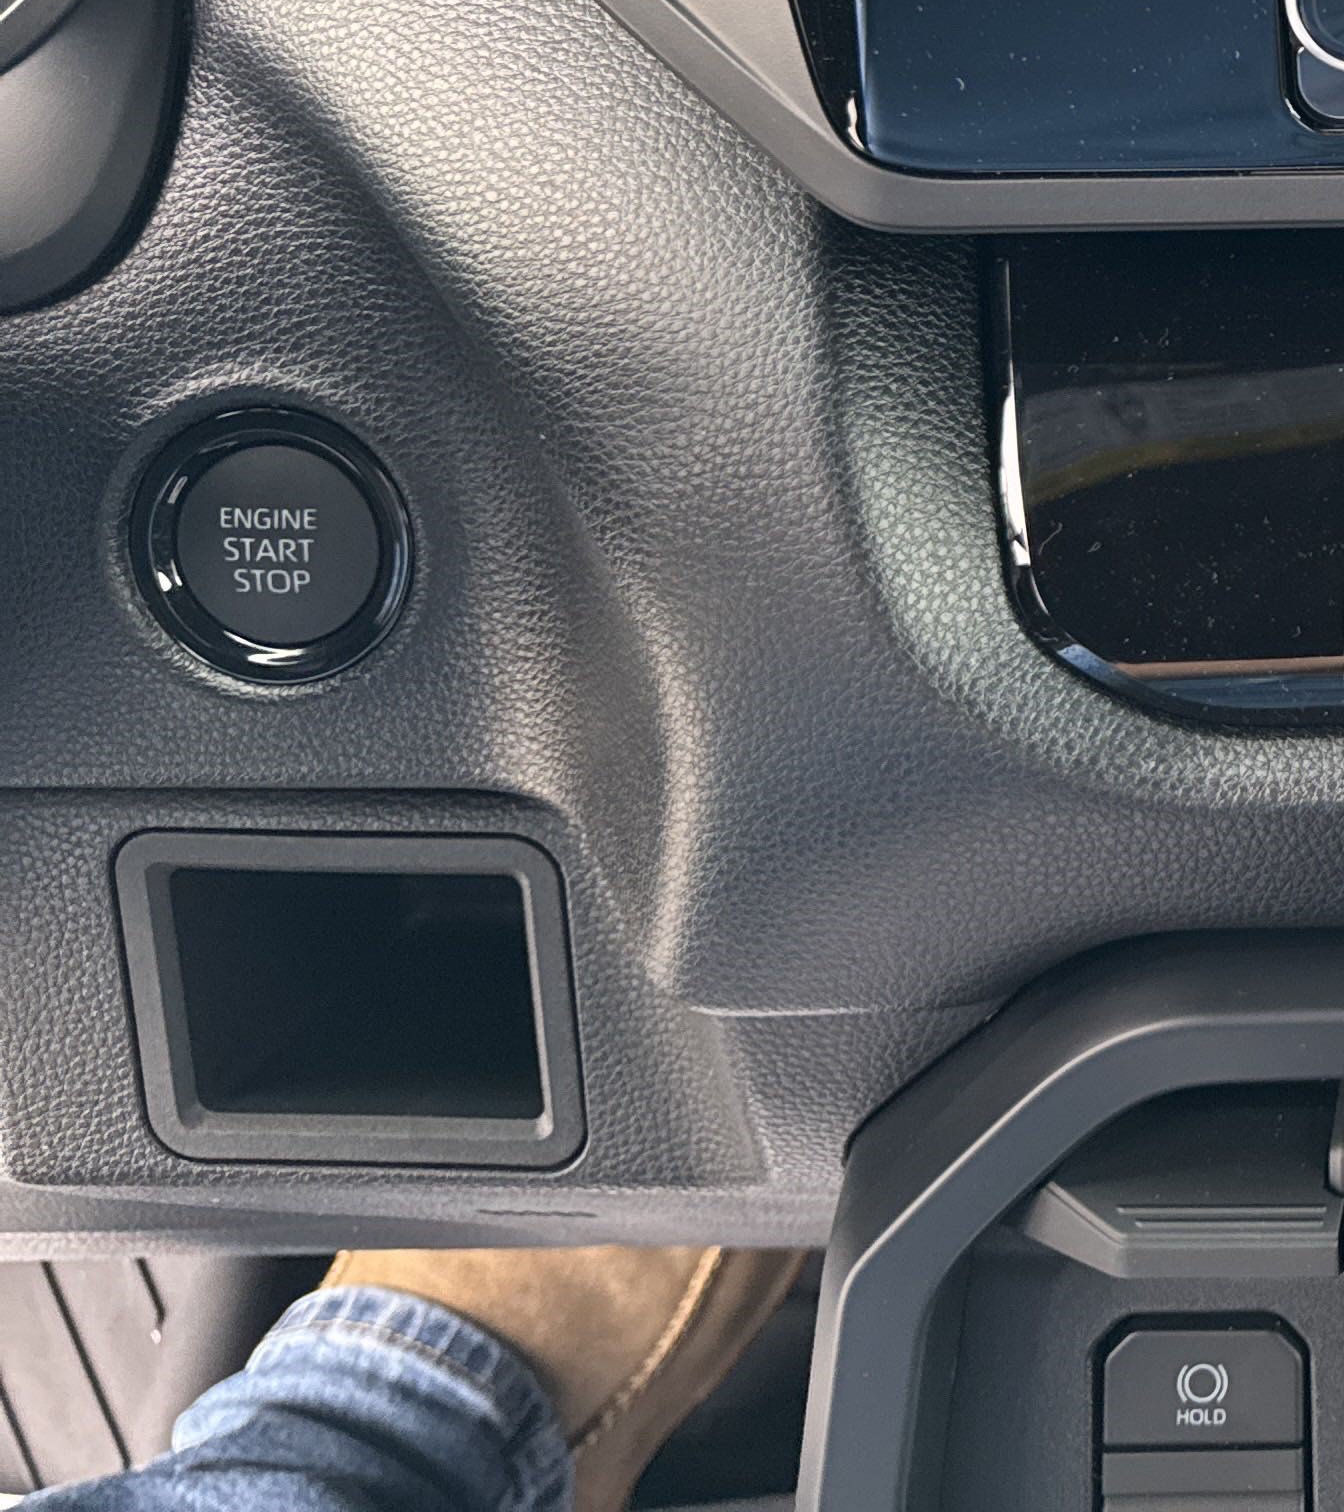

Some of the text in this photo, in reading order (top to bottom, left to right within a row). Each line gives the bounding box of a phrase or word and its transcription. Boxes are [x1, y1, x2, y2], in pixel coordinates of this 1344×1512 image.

[220, 507, 318, 530] ENGINE
[223, 538, 314, 563] START
[233, 569, 311, 593] STOP
[1176, 1408, 1227, 1426] HOLD
